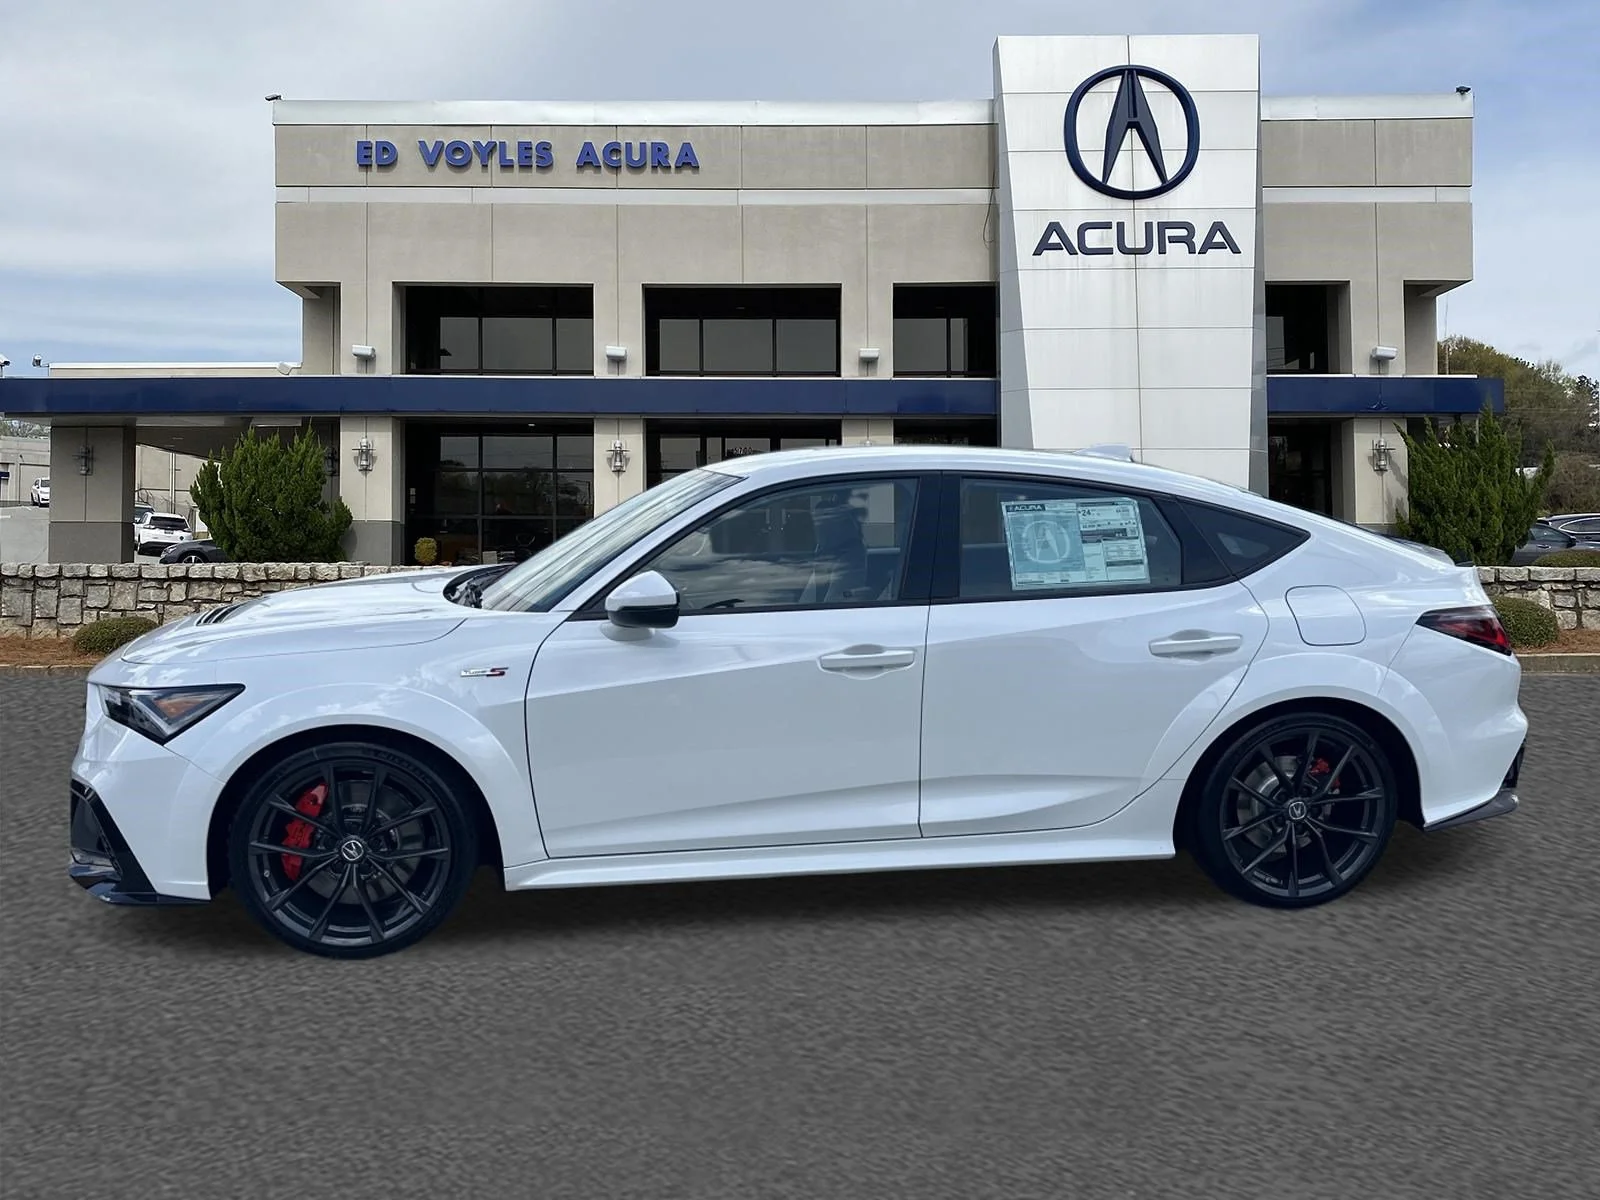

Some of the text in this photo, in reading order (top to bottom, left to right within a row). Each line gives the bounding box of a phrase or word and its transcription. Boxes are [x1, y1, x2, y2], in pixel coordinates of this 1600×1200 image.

[356, 140, 700, 168] ED VOYLES ACURA
[1032, 221, 1242, 256] ACURA
[486, 667, 509, 677] S
